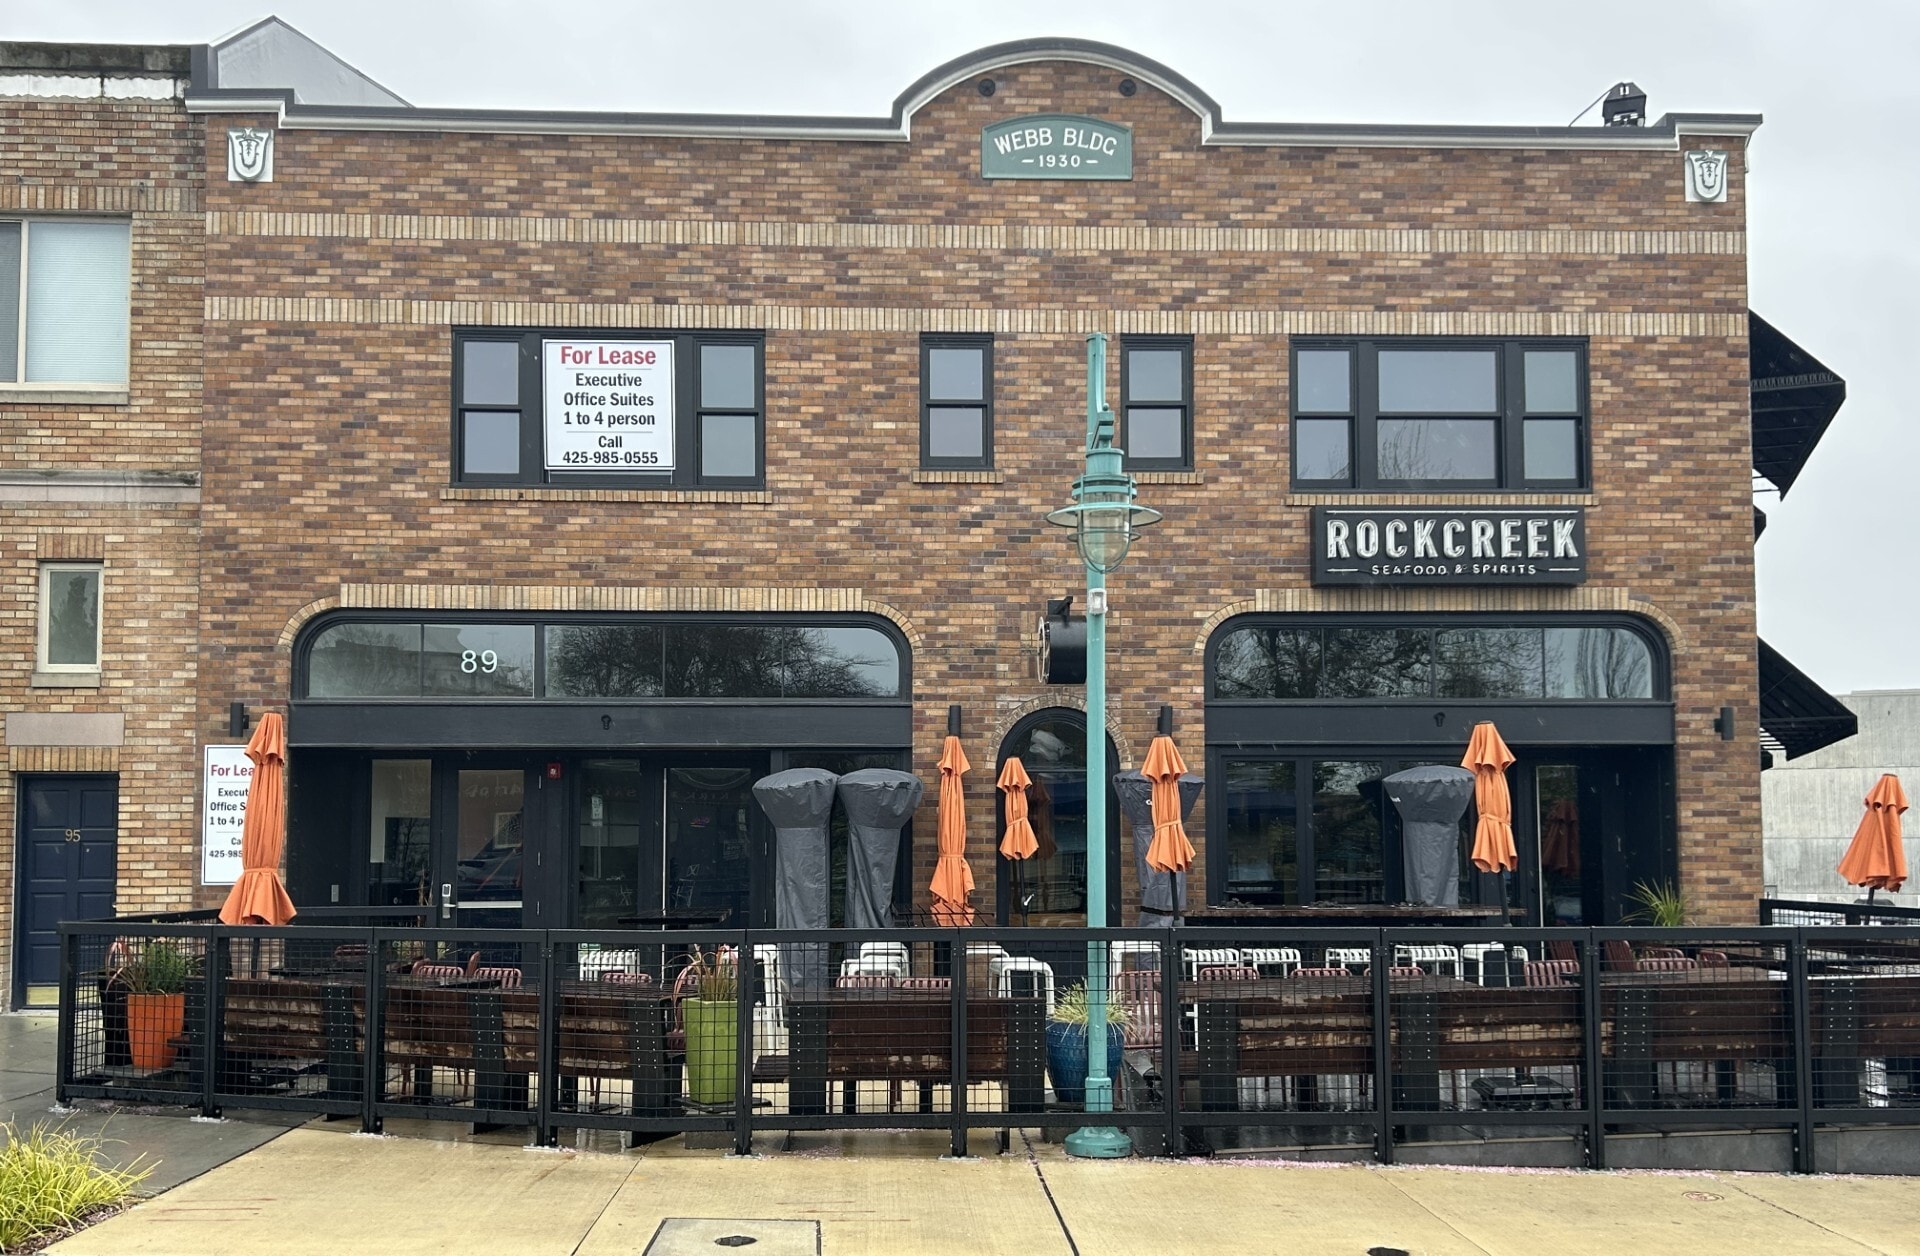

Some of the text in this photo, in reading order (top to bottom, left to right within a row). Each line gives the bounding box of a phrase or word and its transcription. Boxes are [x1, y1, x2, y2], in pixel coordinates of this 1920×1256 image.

[994, 127, 1117, 156] WEBB BLDG
[1039, 154, 1081, 168] 1930
[560, 345, 656, 365] For Lease
[575, 372, 642, 387] Executive
[563, 391, 654, 406] Office Suites
[563, 411, 655, 428] 1 to 4 person
[598, 435, 623, 448] Call
[562, 451, 658, 464] 425-985-0555
[1327, 518, 1579, 559] ROCKCREEK
[1371, 563, 1536, 575] SEAFOOD & SPIRITS
[461, 649, 498, 674] 89
[210, 764, 254, 777] For Lea
[218, 787, 249, 797] Execut
[210, 801, 238, 811] Office
[209, 816, 215, 826] 1
[217, 816, 227, 826] to
[229, 816, 236, 826] 4
[65, 828, 81, 842] 95
[231, 836, 242, 846] Ca
[208, 850, 243, 858] 425-985
